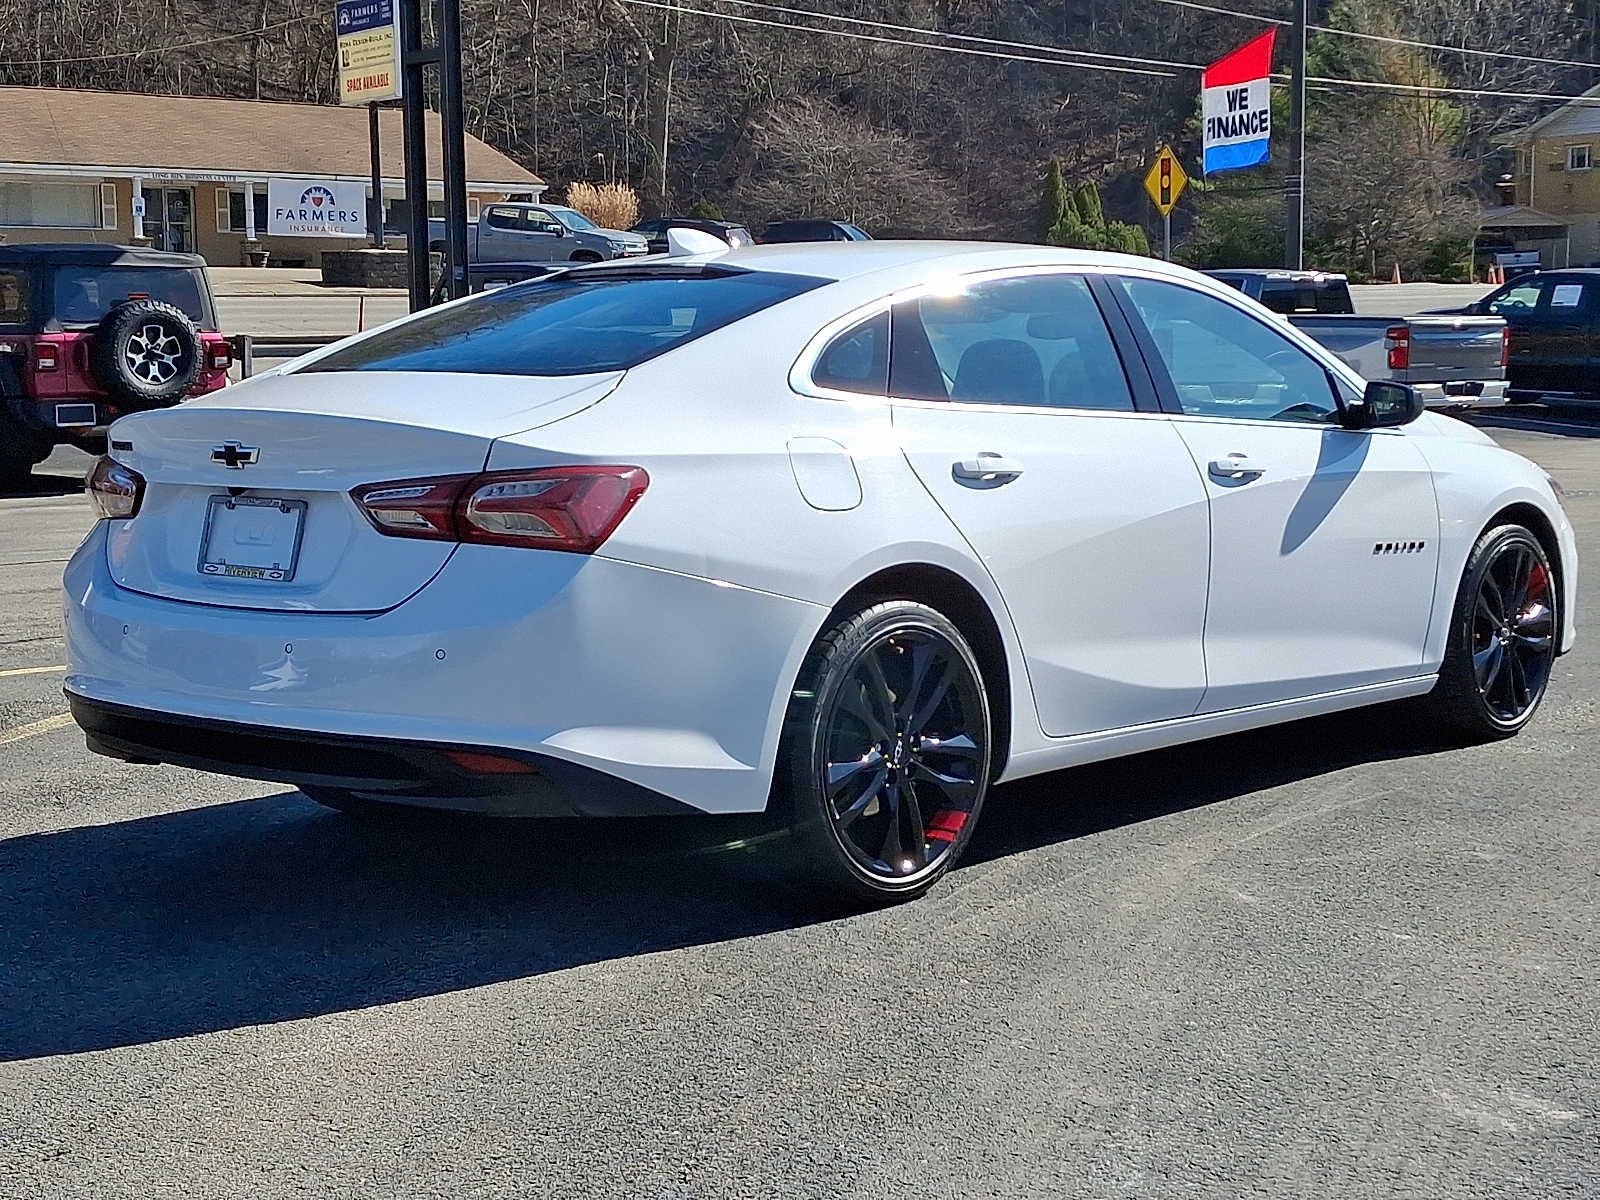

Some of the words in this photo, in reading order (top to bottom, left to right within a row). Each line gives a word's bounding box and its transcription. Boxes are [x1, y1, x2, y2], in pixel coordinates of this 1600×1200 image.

[351, 4, 379, 18] FARMERS
[347, 77, 362, 93] SPACE
[363, 72, 389, 90] AVAILABLE
[1227, 88, 1249, 112] WE
[1207, 109, 1269, 141] FINANCE
[276, 208, 358, 222] FARMERS
[289, 224, 345, 233] INSURANCE
